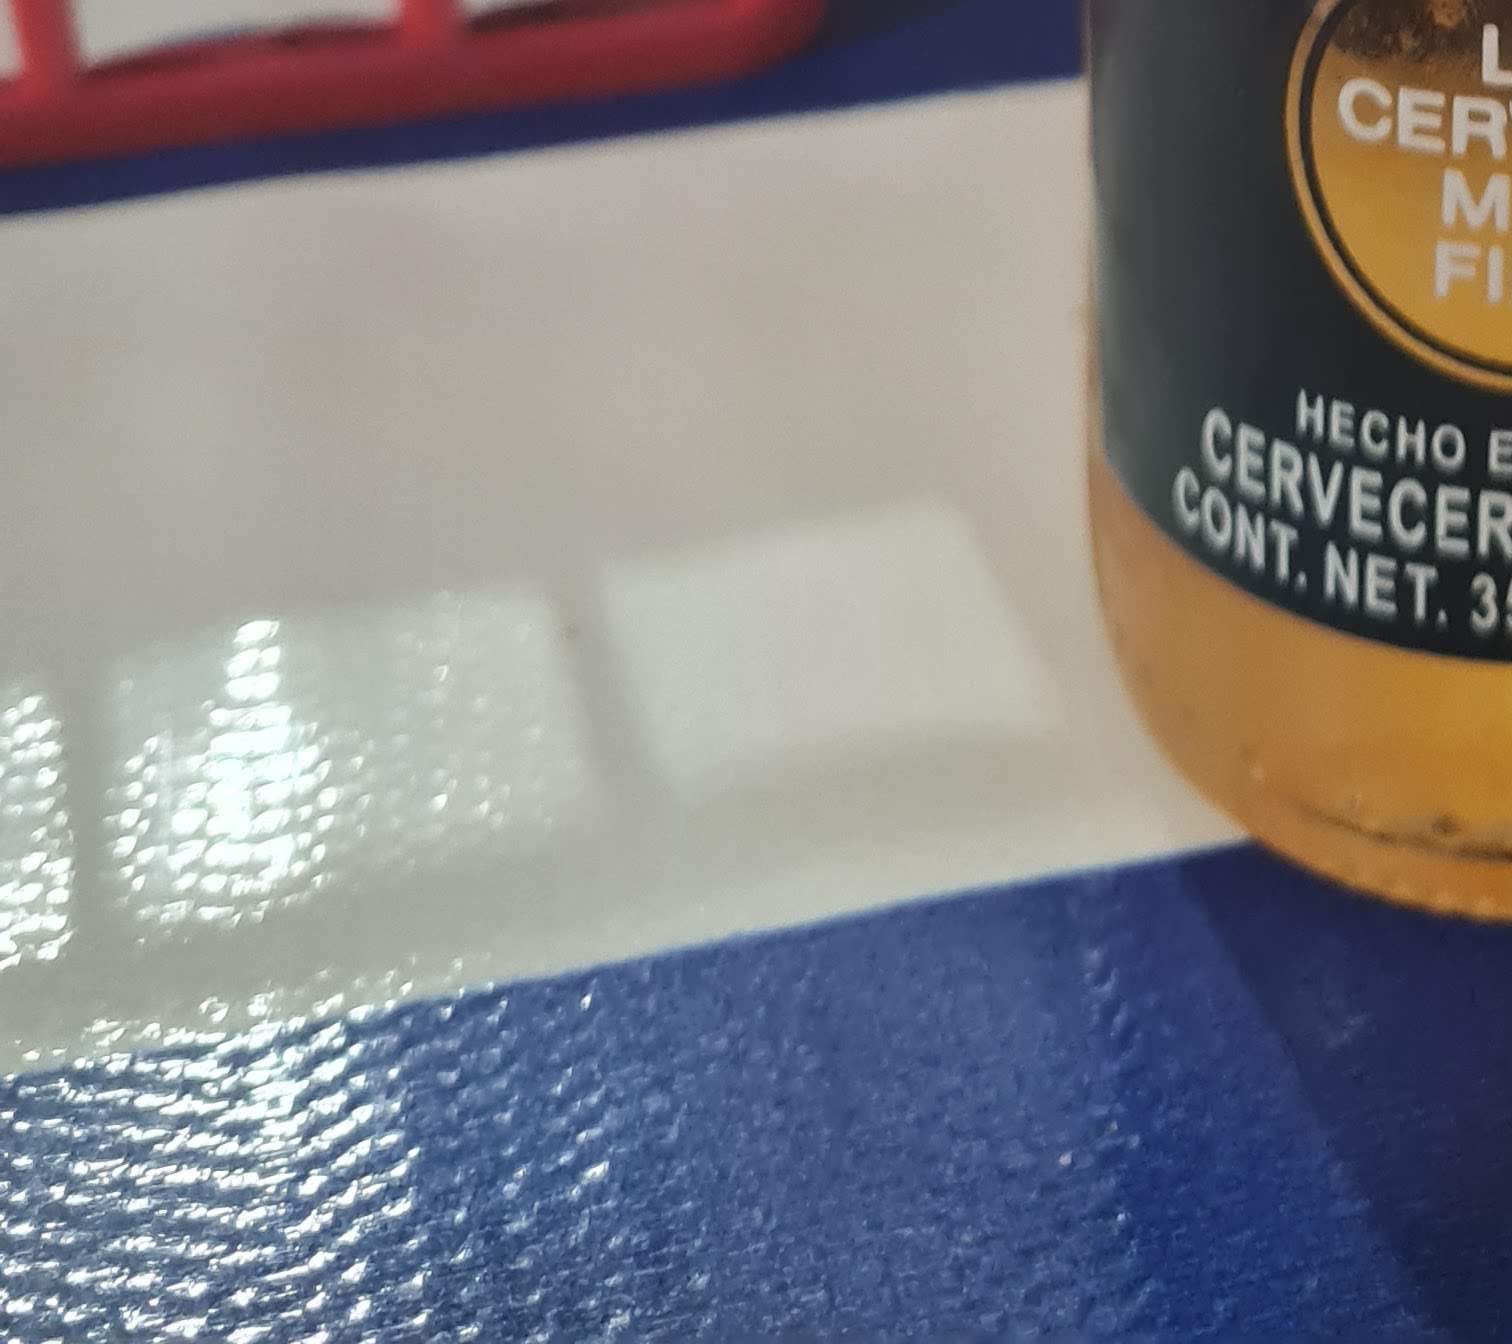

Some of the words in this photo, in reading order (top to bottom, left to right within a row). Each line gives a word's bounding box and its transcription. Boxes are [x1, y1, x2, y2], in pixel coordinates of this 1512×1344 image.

[1295, 387, 1468, 473] HECHO
[1171, 464, 1308, 594] CONT.
[1321, 539, 1449, 629] NET.
